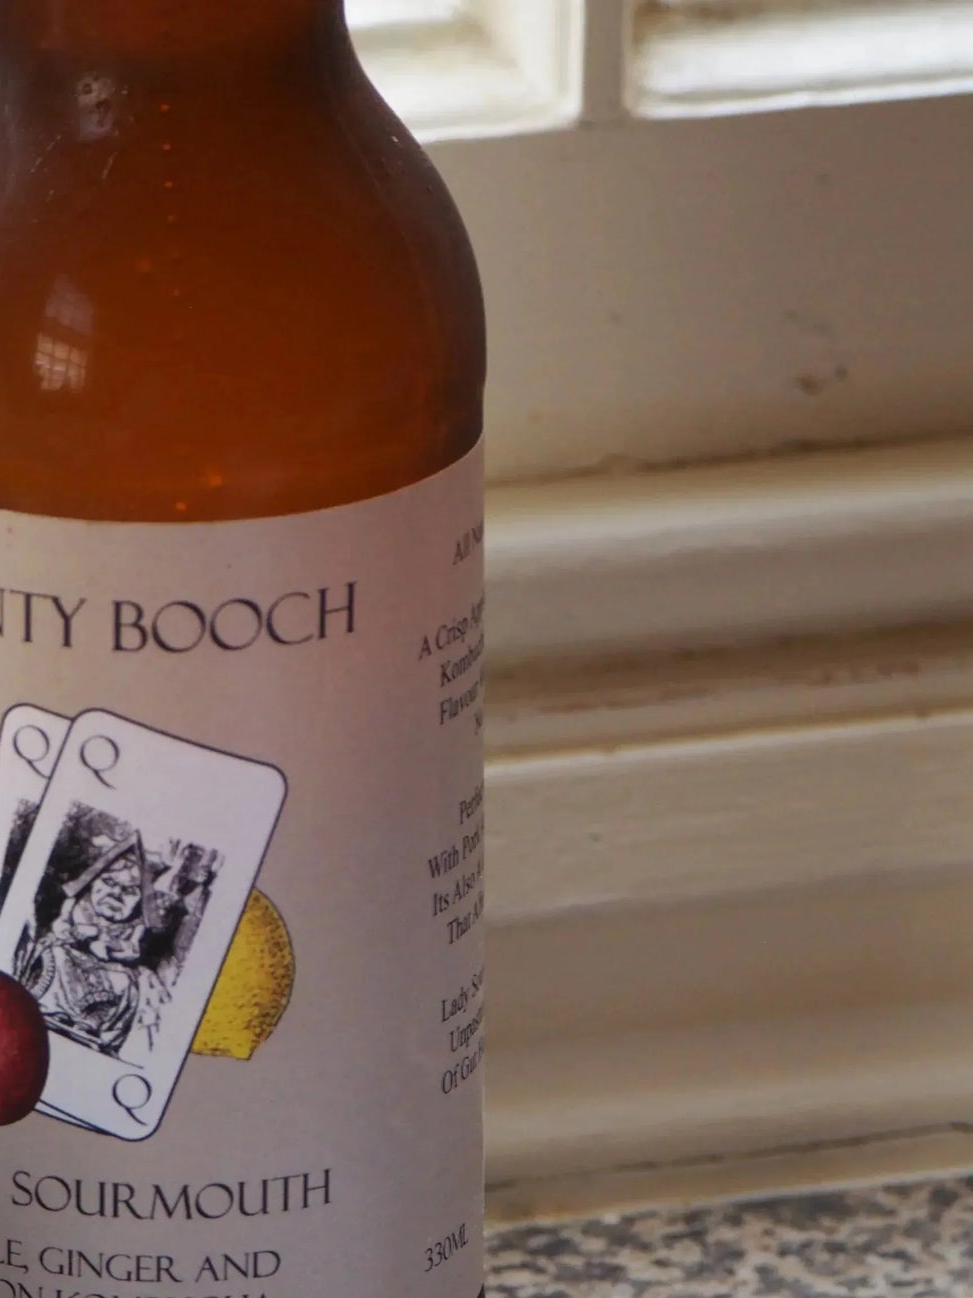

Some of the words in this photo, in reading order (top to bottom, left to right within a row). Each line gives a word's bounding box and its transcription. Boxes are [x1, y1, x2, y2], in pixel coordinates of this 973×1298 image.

[111, 581, 358, 654] BOOCH
[418, 635, 433, 661] A
[11, 724, 50, 780] Q
[79, 734, 121, 790] Q
[427, 845, 459, 879] With
[433, 892, 450, 917] Its
[110, 1072, 154, 1127] Q
[441, 1063, 459, 1095] Of
[11, 1167, 331, 1221] SOURMOUTH
[38, 1246, 183, 1284] GINGER
[194, 1249, 282, 1283] AND
[423, 1223, 469, 1273] 330ML
